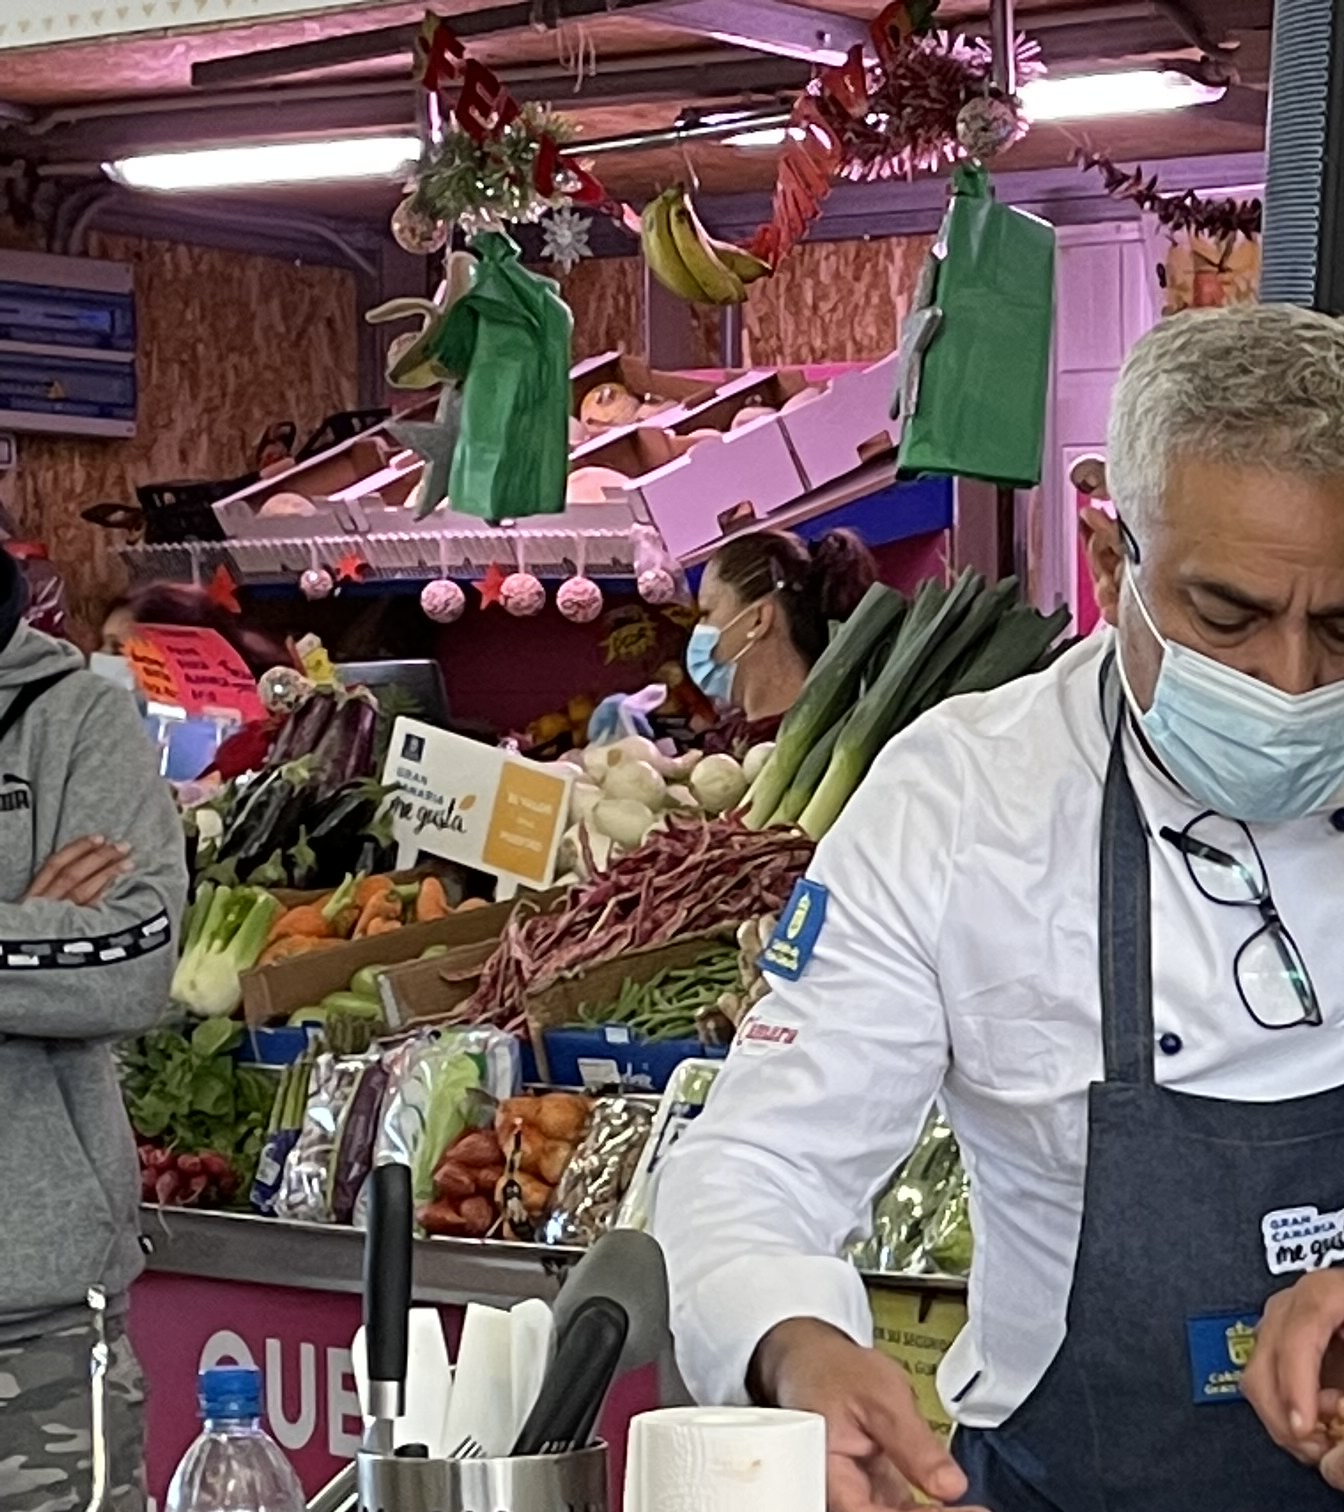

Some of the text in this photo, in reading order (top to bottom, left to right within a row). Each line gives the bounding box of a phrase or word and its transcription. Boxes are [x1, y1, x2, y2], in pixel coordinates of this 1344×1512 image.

[414, 797, 467, 835] gusta
[1270, 1216, 1312, 1231] GRAN
[1271, 1222, 1336, 1243] CANARIA
[1276, 1244, 1308, 1265] me
